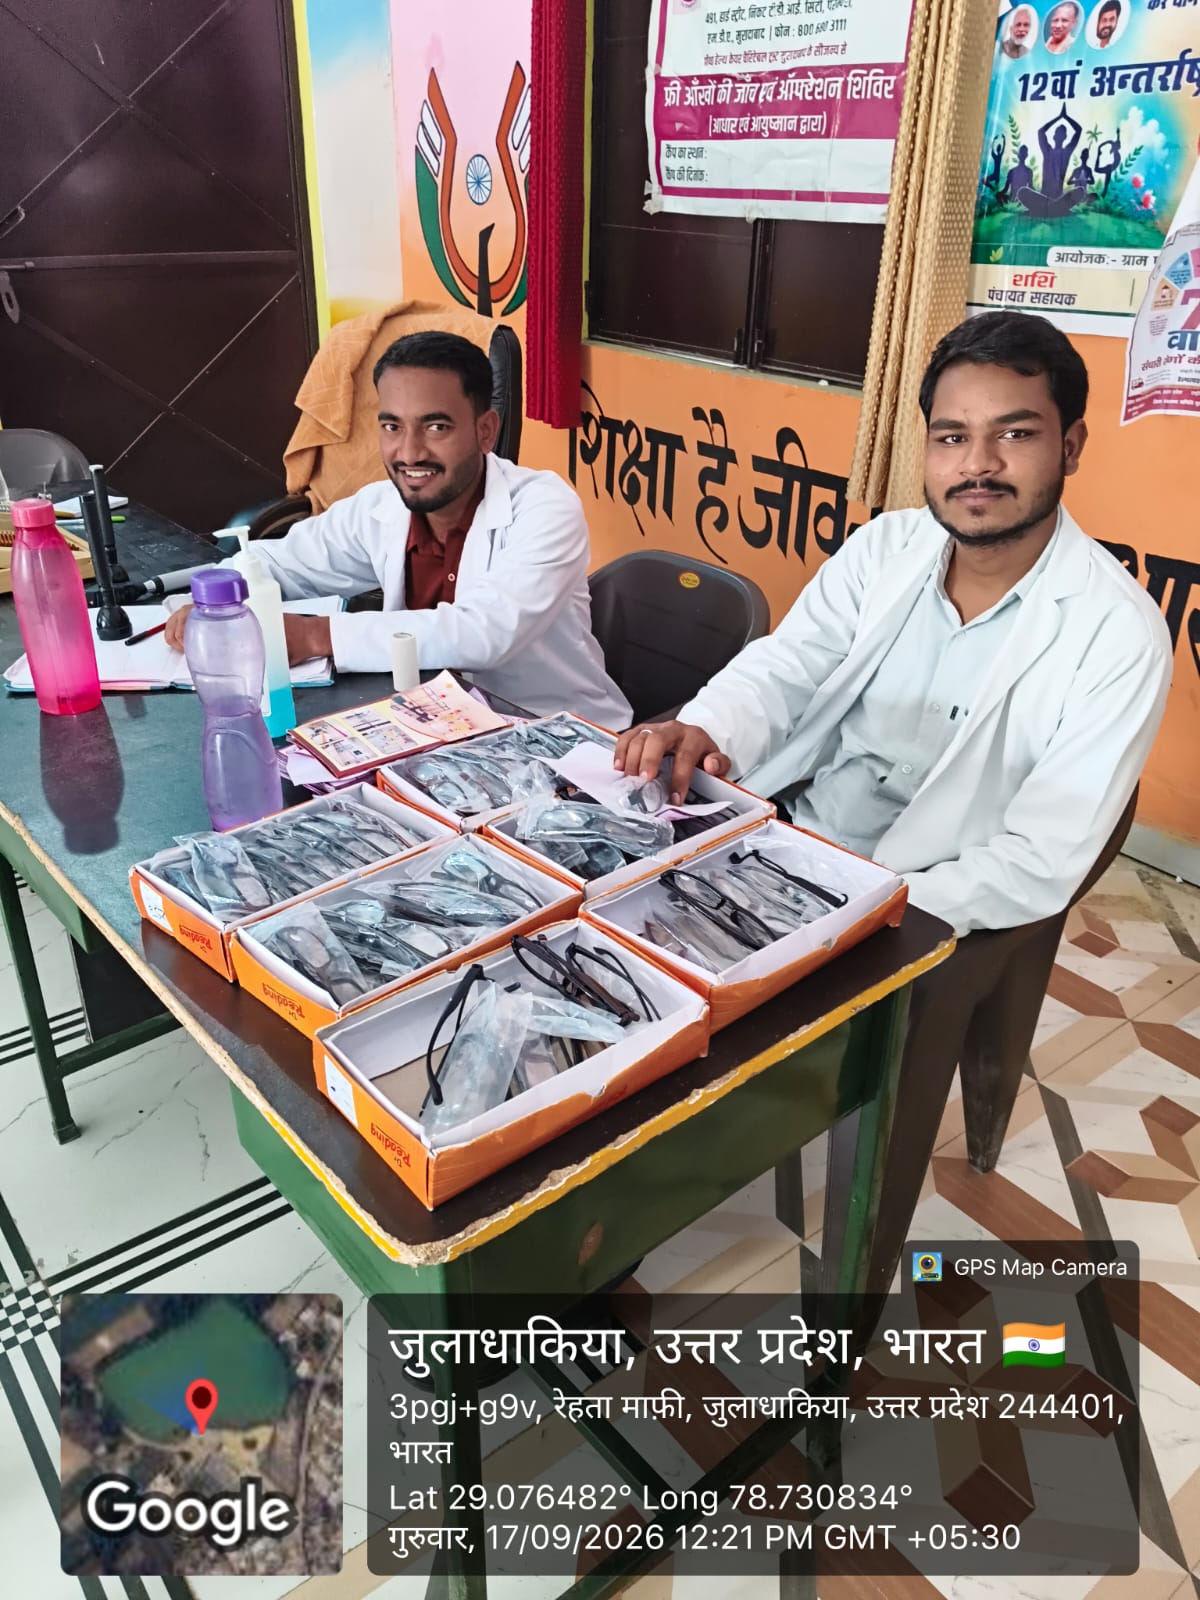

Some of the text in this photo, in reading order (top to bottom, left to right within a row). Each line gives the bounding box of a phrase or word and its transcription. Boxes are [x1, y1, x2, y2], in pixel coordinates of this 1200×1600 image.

[736, 28, 765, 46] मुरादाबाद
[798, 23, 814, 38] 800
[829, 18, 847, 33] 3111
[840, 40, 848, 55] से
[664, 80, 680, 107] फ्री
[684, 77, 714, 107] आँखों
[717, 78, 731, 105] की
[846, 69, 896, 100] शिविर
[1018, 59, 1083, 102] 12वां
[738, 113, 751, 134] एवं
[750, 114, 797, 137] आयुष्मान
[799, 111, 827, 136] द्वारा)
[1121, 254, 1148, 267] ग्राम
[1012, 271, 1057, 288] शशि
[988, 287, 1077, 306] पंचायत सहायक
[569, 380, 883, 567] शिक्षा है जीव
[262, 982, 305, 1019] Reading
[370, 1122, 411, 1168] Reading
